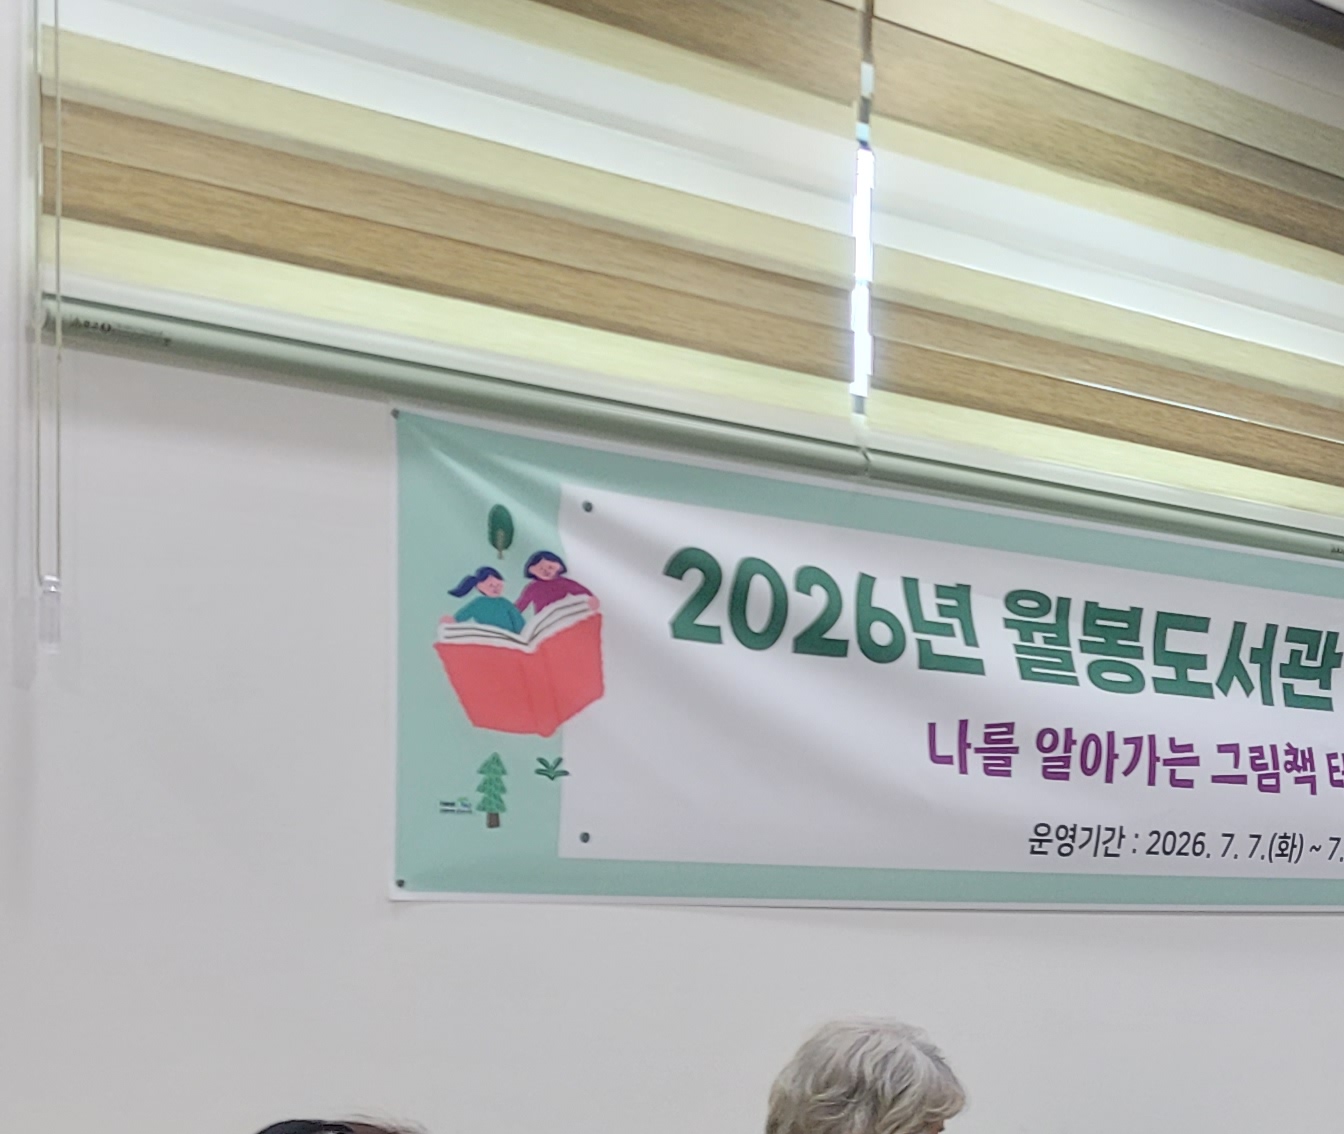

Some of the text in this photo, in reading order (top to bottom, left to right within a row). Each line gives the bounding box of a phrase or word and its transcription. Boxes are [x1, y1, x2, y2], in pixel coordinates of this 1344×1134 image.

[663, 546, 986, 676] 2026년
[1002, 589, 1344, 712] 월봉도서관
[927, 718, 1019, 778] 나를
[1035, 726, 1200, 789] 알아가는
[1210, 741, 1318, 796] 그림책
[1028, 822, 1126, 858] 운영기간
[1145, 830, 1211, 859] 2026.
